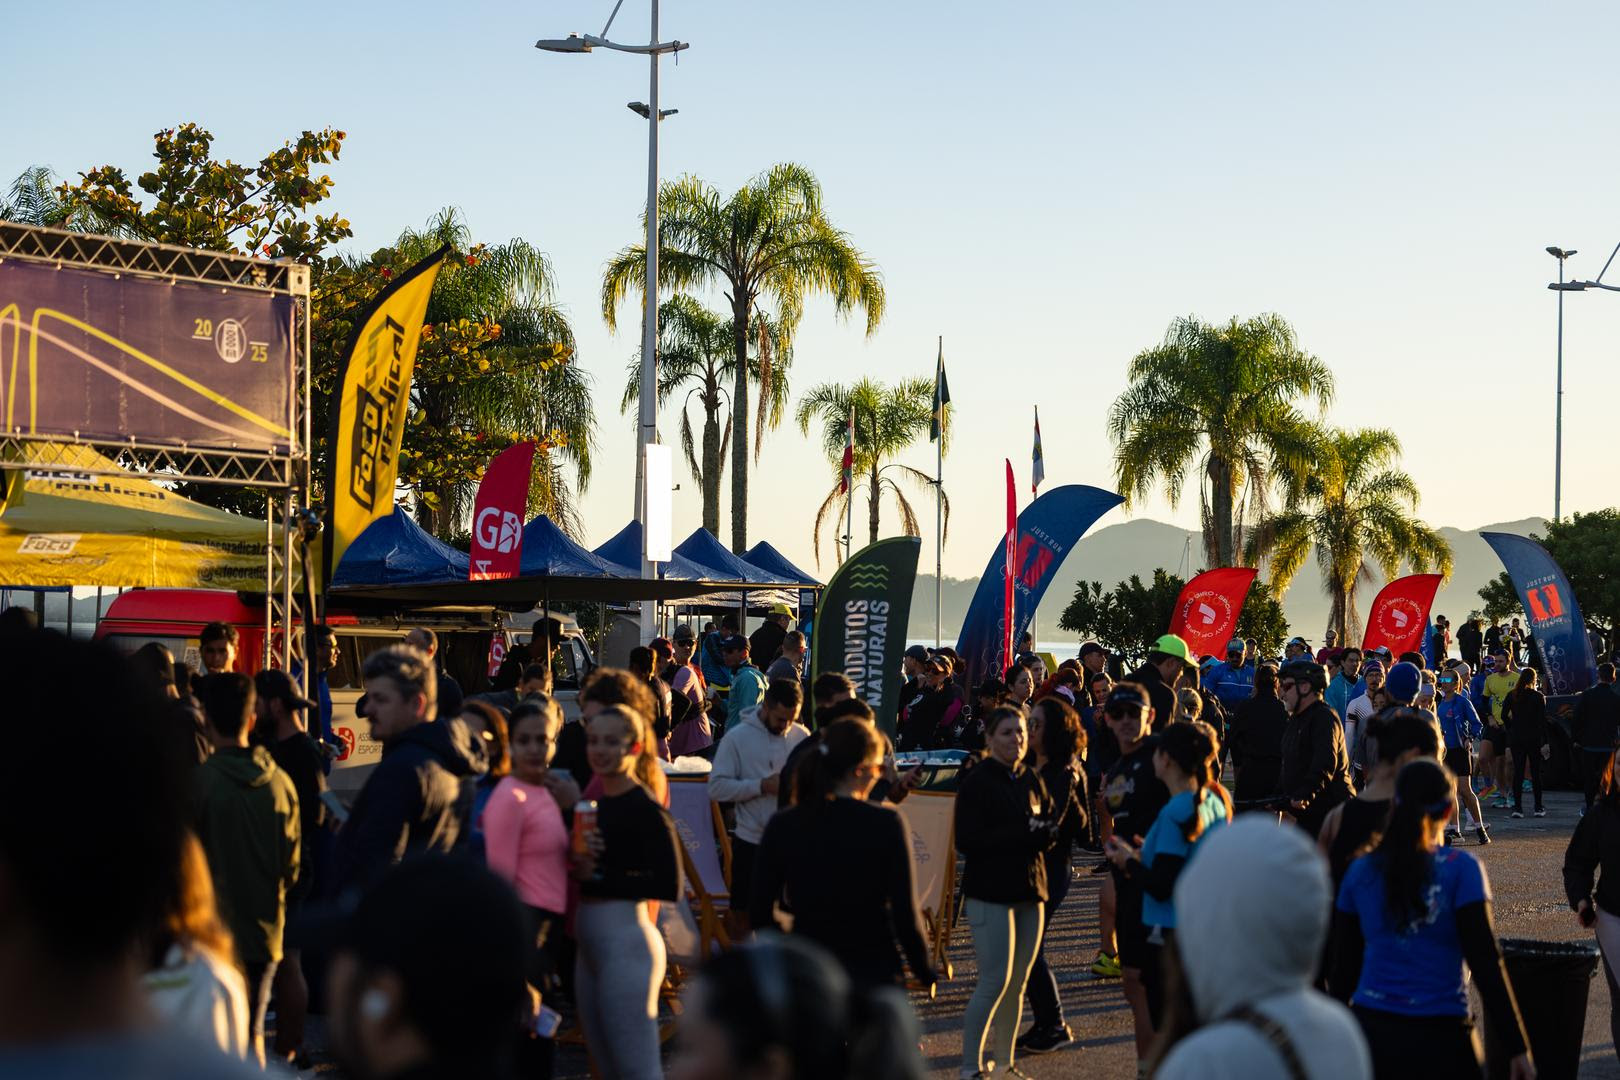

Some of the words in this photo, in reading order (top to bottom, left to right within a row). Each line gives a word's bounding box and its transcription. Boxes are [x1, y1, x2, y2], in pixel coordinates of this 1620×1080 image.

[194, 318, 213, 337] 20
[250, 345, 268, 363] 25
[1031, 526, 1049, 542] JUST
[1048, 539, 1063, 553] RUN
[1526, 578, 1542, 589] JUST
[1183, 598, 1194, 618] ALTO
[1194, 590, 1214, 599] GIRO
[1218, 594, 1232, 620] SPORT
[1377, 604, 1387, 623] ALTO
[1409, 600, 1422, 622] SPORT
[1185, 623, 1201, 637] LIFE
[1215, 621, 1229, 635] WAY
[844, 600, 869, 693] RODUTOS
[867, 600, 890, 707] NATURAIS
[358, 745, 383, 754] ESPORT
